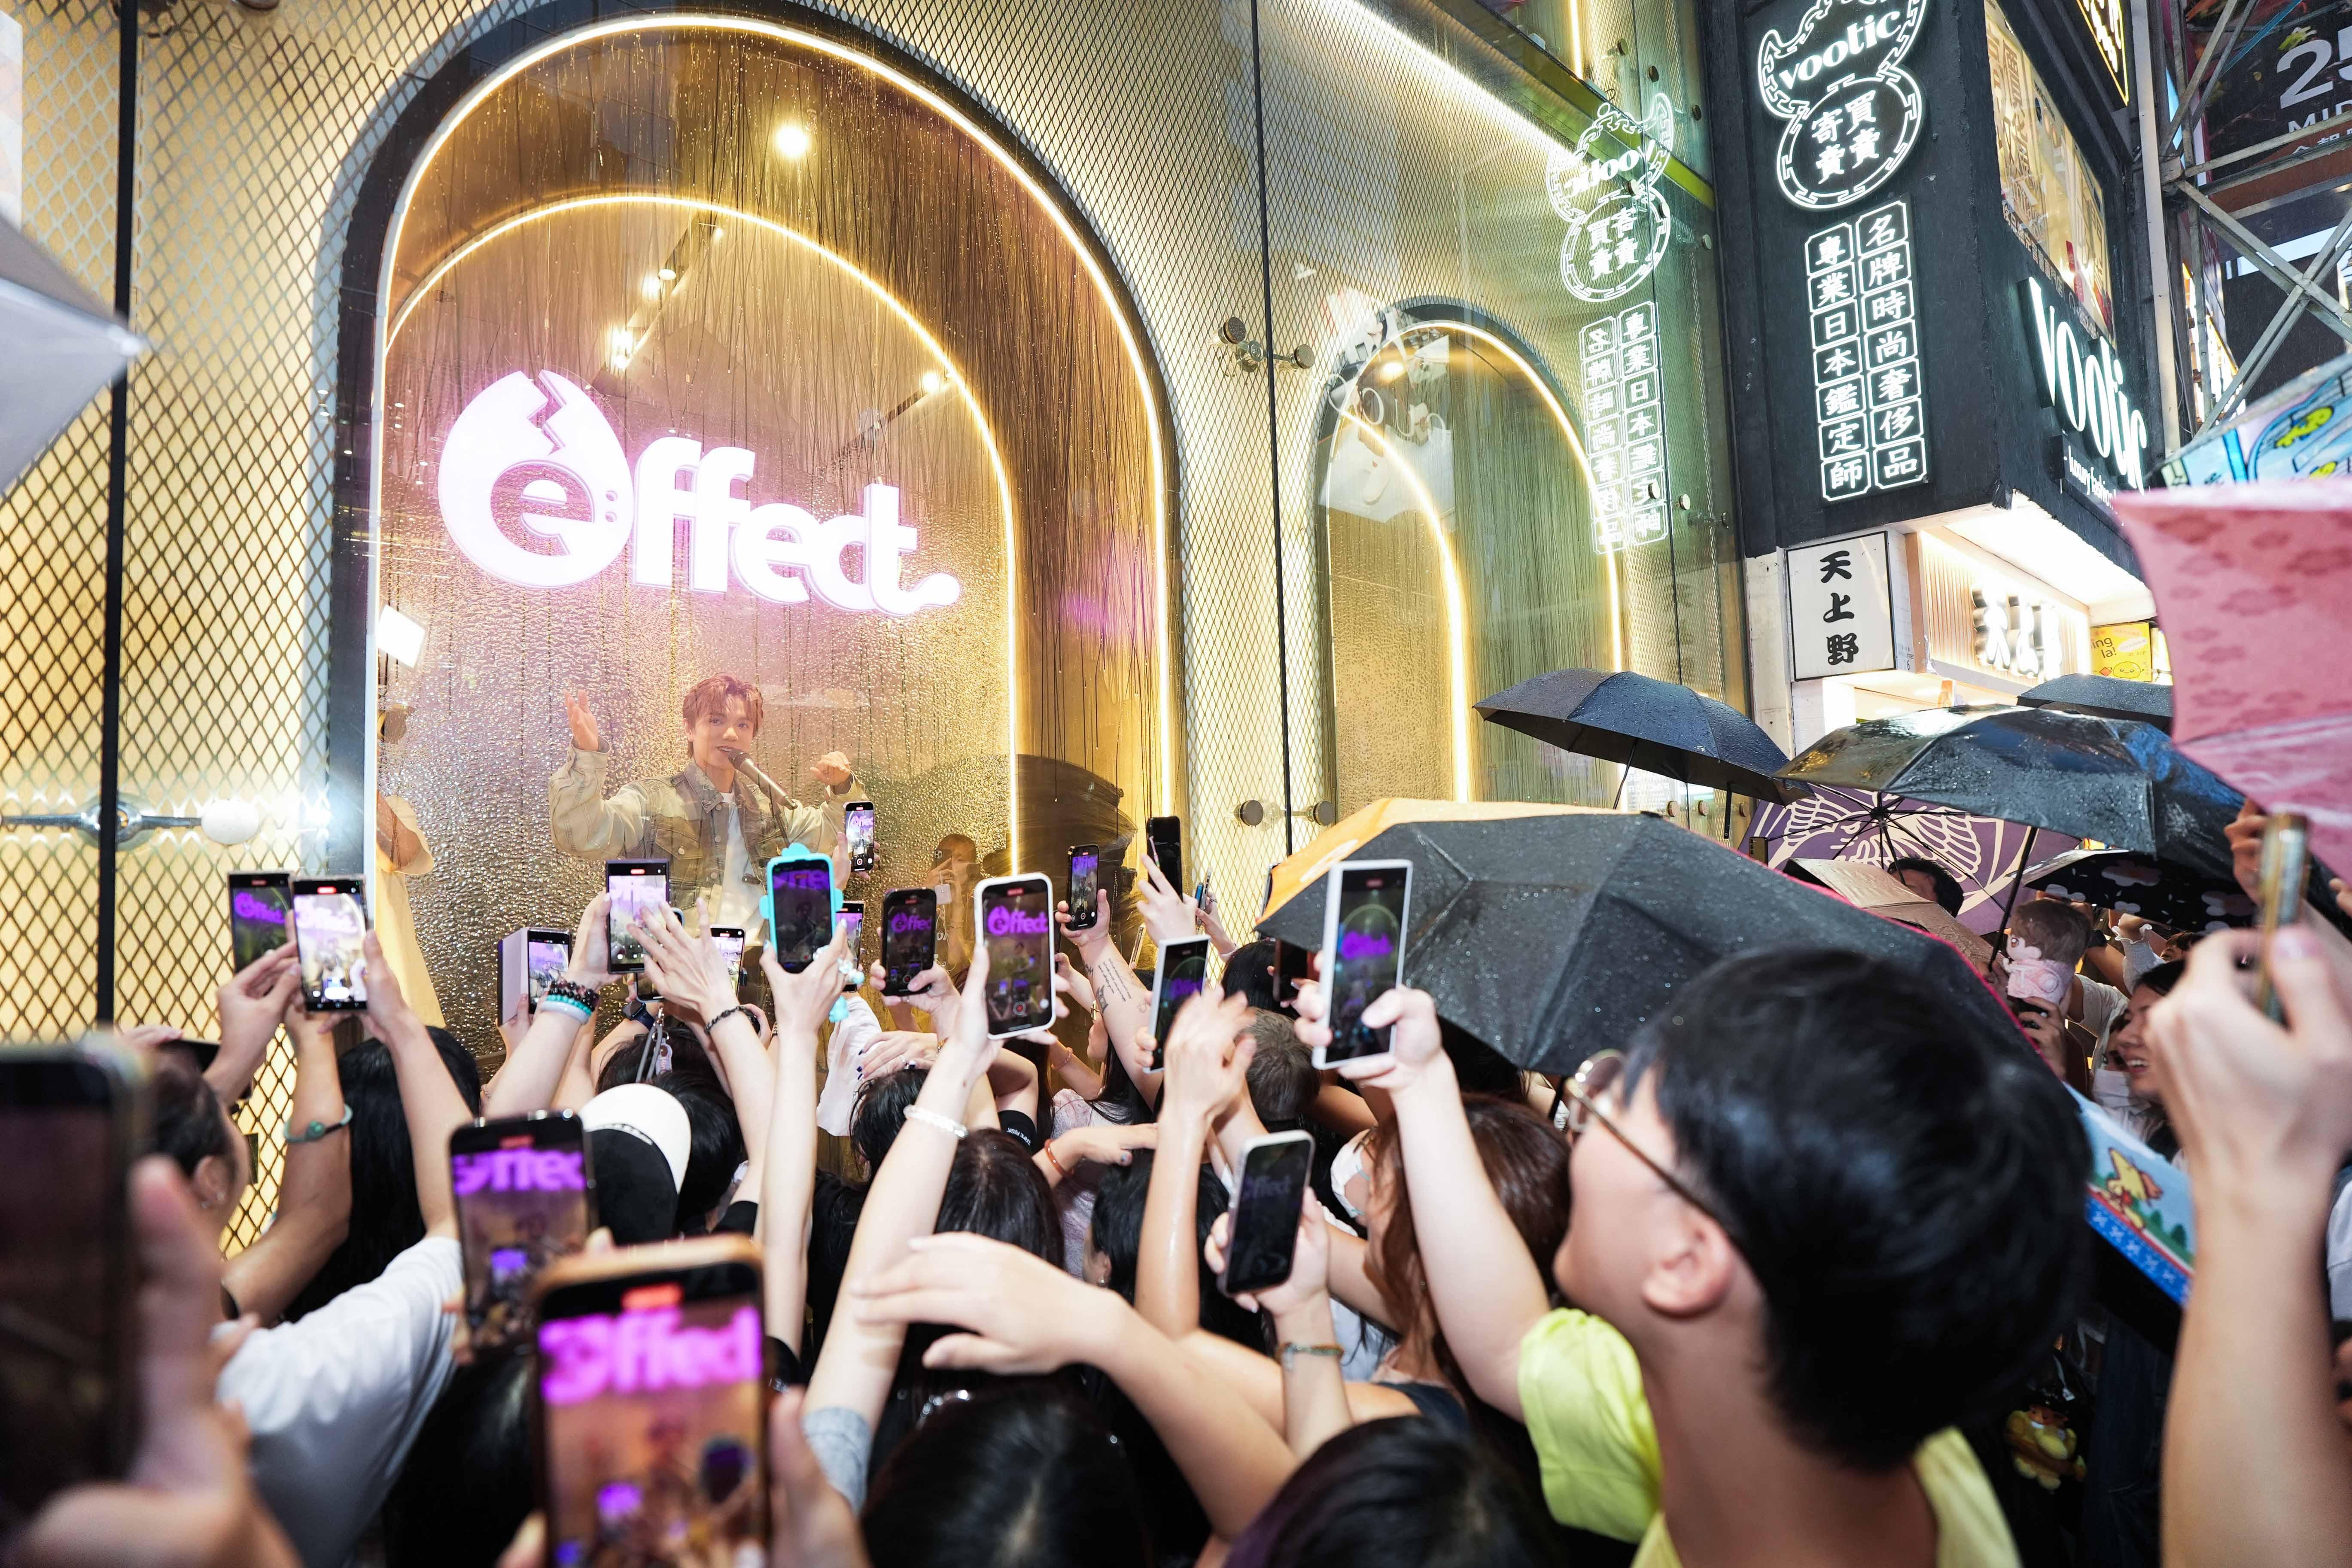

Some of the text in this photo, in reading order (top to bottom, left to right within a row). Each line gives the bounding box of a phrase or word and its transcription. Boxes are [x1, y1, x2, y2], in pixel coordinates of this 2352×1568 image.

[1779, 11, 1901, 89] vootic
[2276, 26, 2352, 109] 2
[1815, 236, 1862, 489] 專業日本鑑定師
[1866, 214, 1917, 478] 名牌時尚奢侈品
[1820, 550, 1859, 666] 天上野
